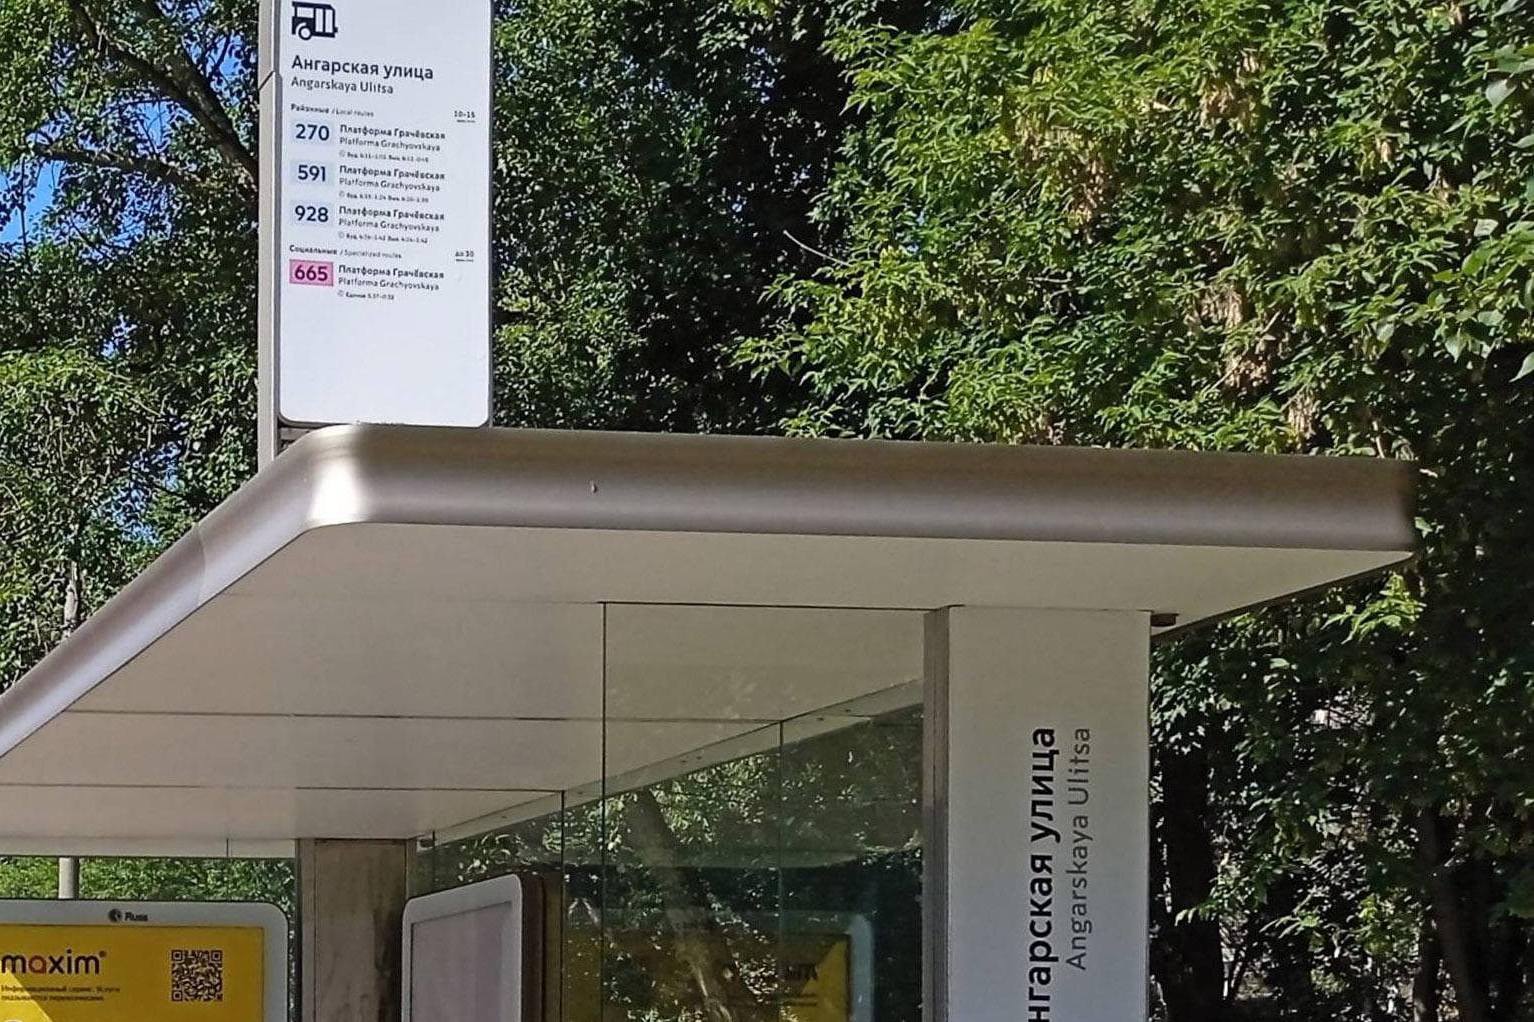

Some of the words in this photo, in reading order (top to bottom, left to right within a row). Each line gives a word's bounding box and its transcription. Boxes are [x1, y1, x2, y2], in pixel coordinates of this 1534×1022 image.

[291, 54, 379, 75] Ангарская
[383, 64, 434, 80] улица
[291, 76, 357, 93] Angarskaya
[360, 81, 394, 94] Ulitsa
[295, 123, 330, 141] 270
[339, 124, 392, 136] Платформа
[339, 137, 379, 147] Platforma
[298, 164, 326, 182] 591
[339, 165, 392, 177] Платформа
[339, 177, 379, 187] Platforma
[295, 205, 329, 223] 928
[339, 206, 391, 218] Платформа
[338, 219, 378, 228] Platforma
[294, 264, 328, 281] 665
[338, 264, 391, 276] Платформа
[338, 277, 378, 287] Platforma
[1068, 728, 1091, 805] Ulitsa
[1030, 728, 1061, 843] улица
[1066, 815, 1094, 970] Angarskaya
